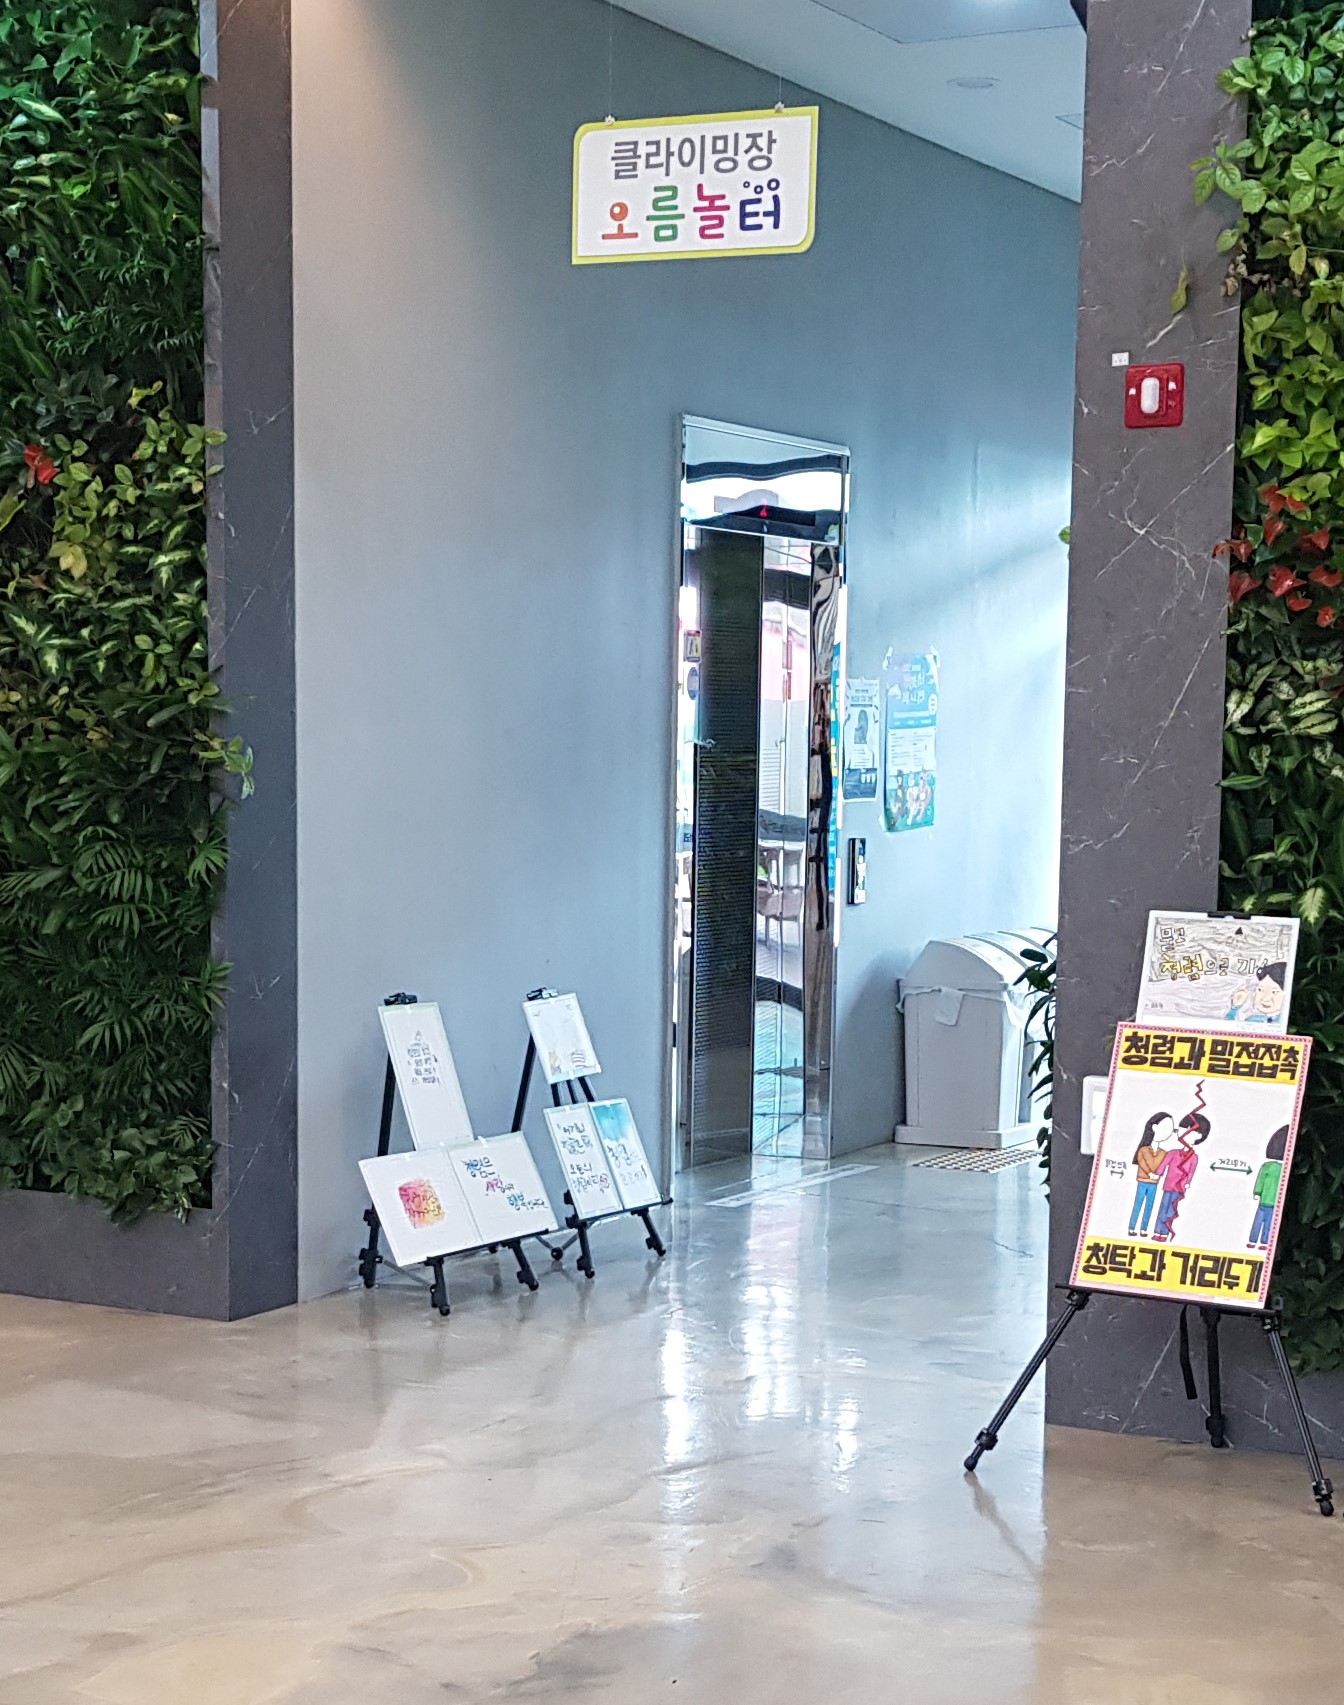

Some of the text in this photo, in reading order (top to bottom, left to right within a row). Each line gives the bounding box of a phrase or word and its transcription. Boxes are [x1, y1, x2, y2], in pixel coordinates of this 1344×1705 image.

[611, 130, 777, 180] 클라이밍장
[602, 179, 781, 243] 오름놀터
[1121, 1031, 1301, 1081] 청렴과 밀접접촉
[1082, 1242, 1264, 1294] 청탁과 거리두기
